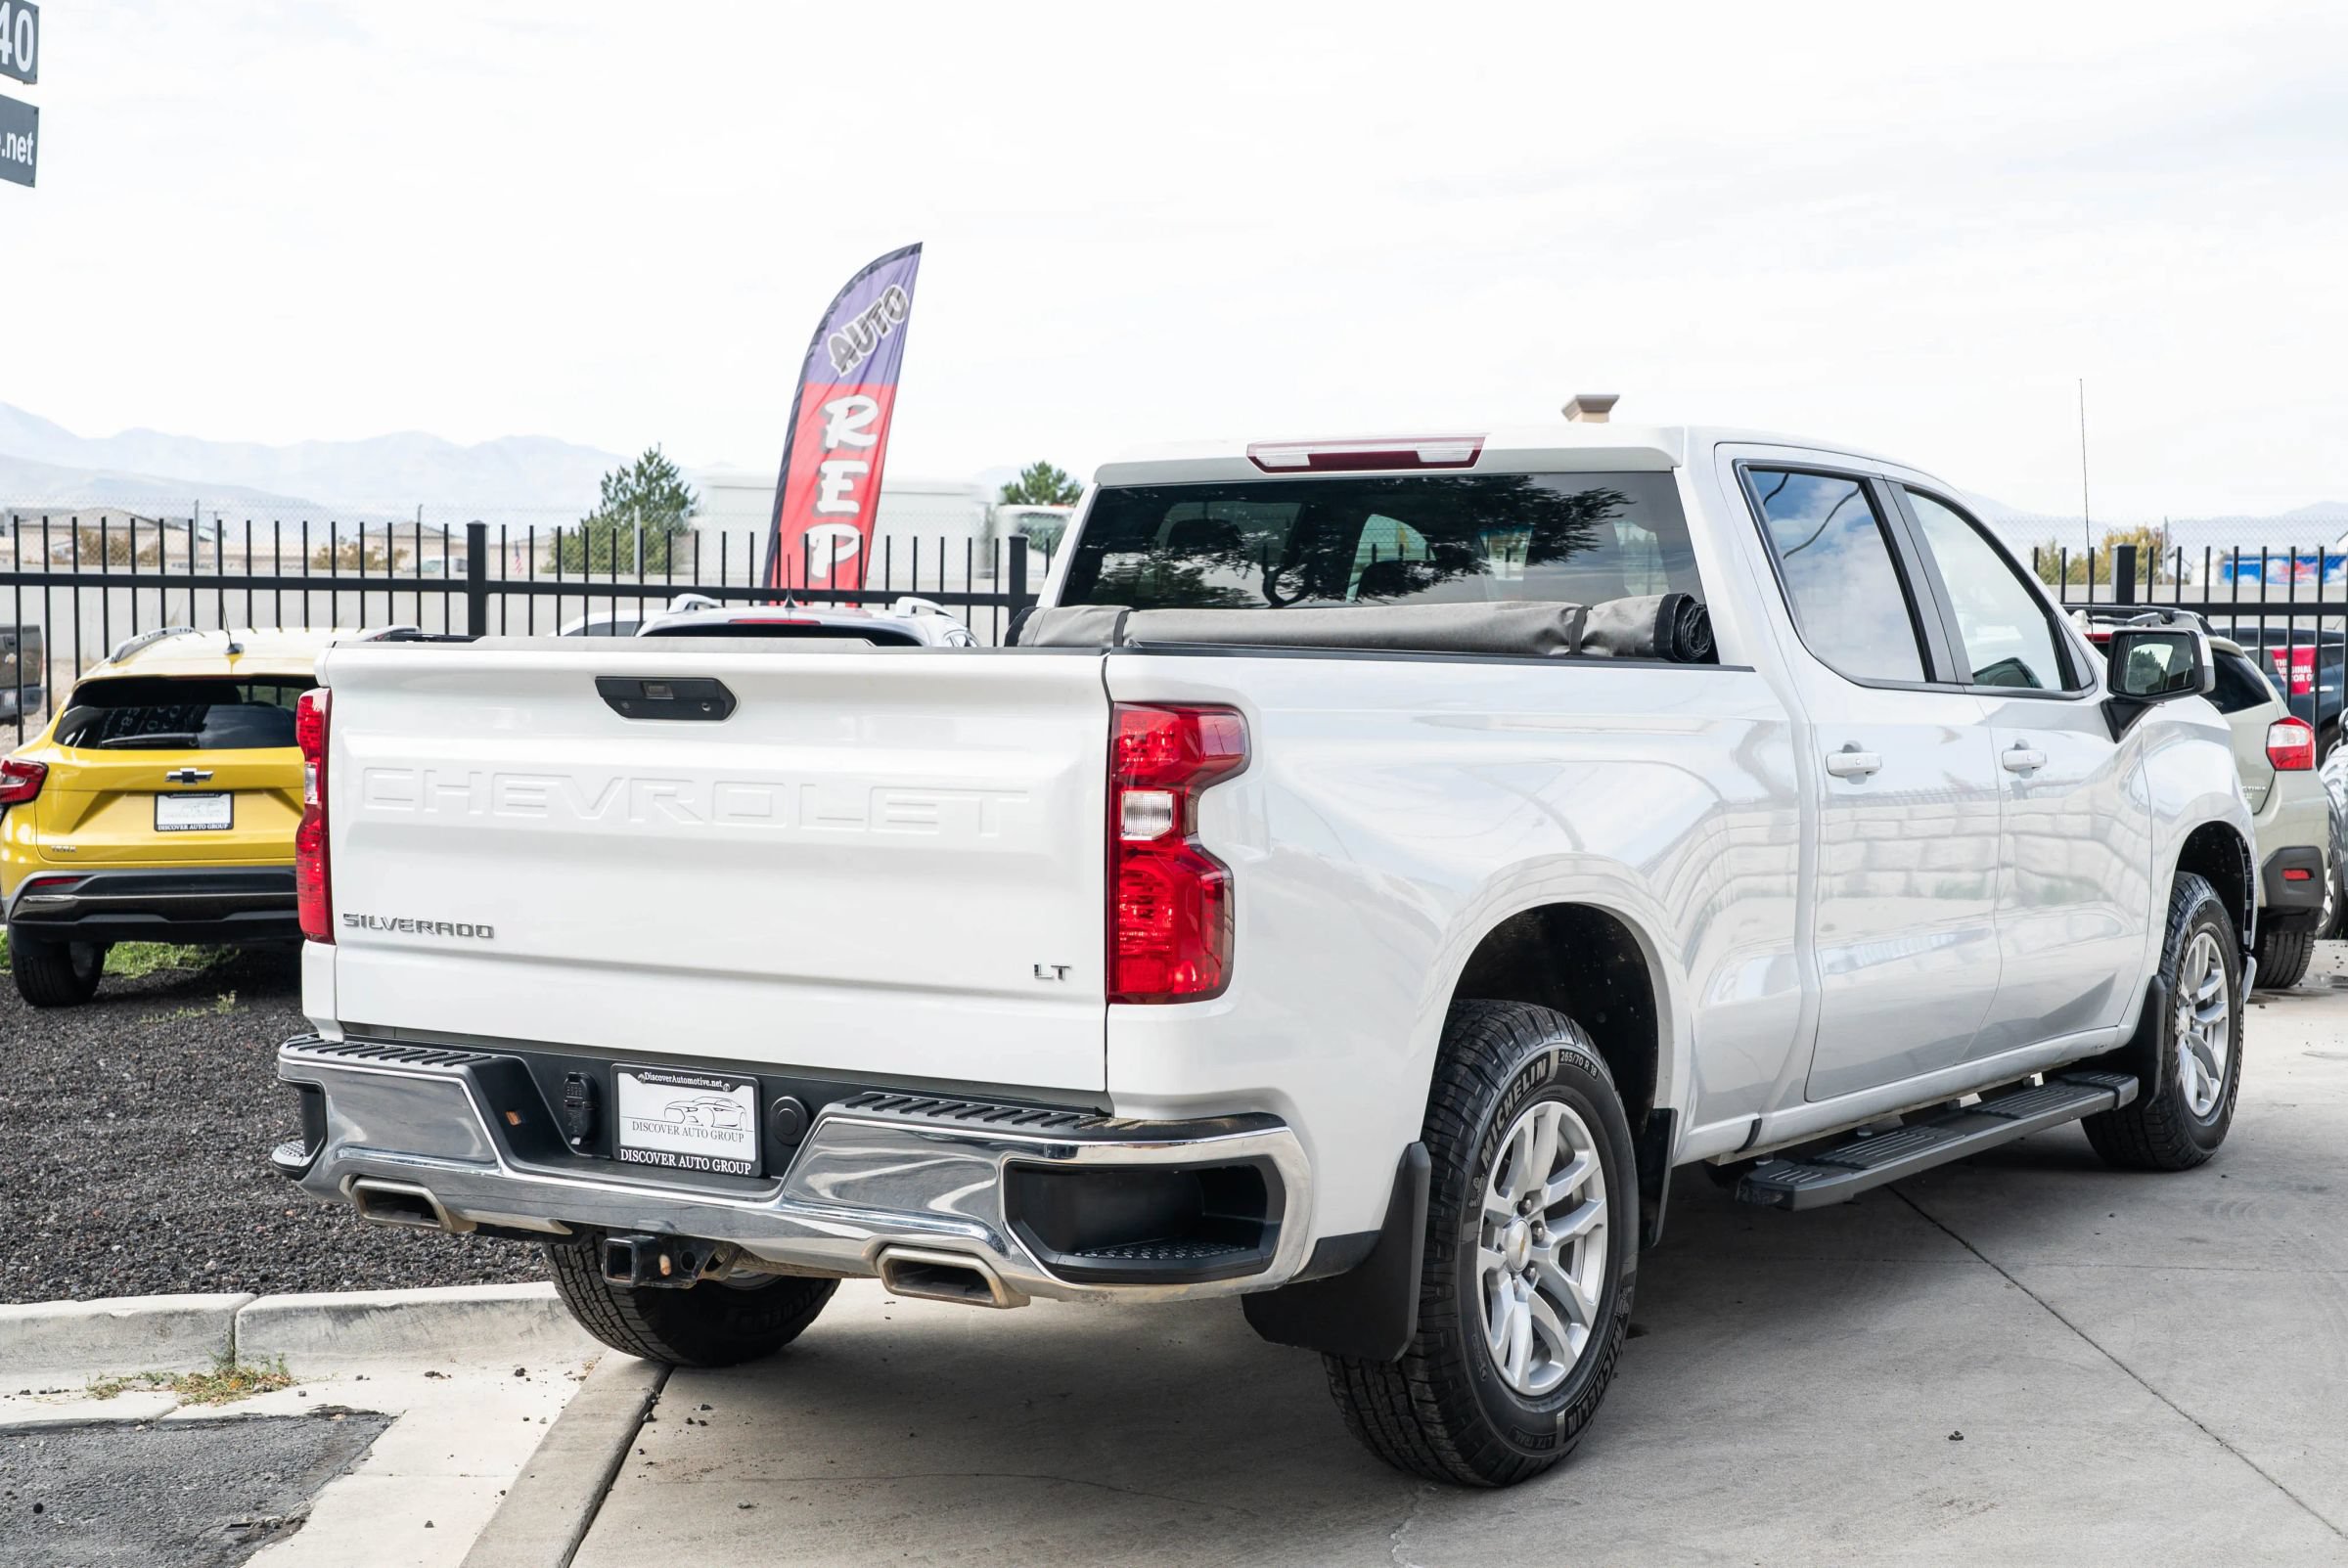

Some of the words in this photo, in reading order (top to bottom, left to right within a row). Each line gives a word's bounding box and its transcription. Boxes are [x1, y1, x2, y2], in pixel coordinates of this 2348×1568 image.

[827, 284, 909, 377] AUTO
[362, 767, 1030, 839] CHEVROLET
[342, 913, 495, 939] SILVERADO
[1033, 963, 1072, 981] LT
[1559, 1052, 1584, 1067] 265/70
[1584, 1059, 1591, 1072] R
[1590, 1065, 1599, 1077] 18
[644, 1071, 723, 1089] DiscoverAutomotive.net
[1480, 1058, 1548, 1170] MICHELIN
[632, 1121, 680, 1136] DISCOVER
[681, 1128, 709, 1140] AUTO
[710, 1131, 745, 1143] GROUP
[620, 1148, 677, 1167] DISCOVER
[679, 1155, 710, 1171] AUTO
[712, 1160, 751, 1175] GROUP
[1567, 1318, 1624, 1436] MICHELIN
